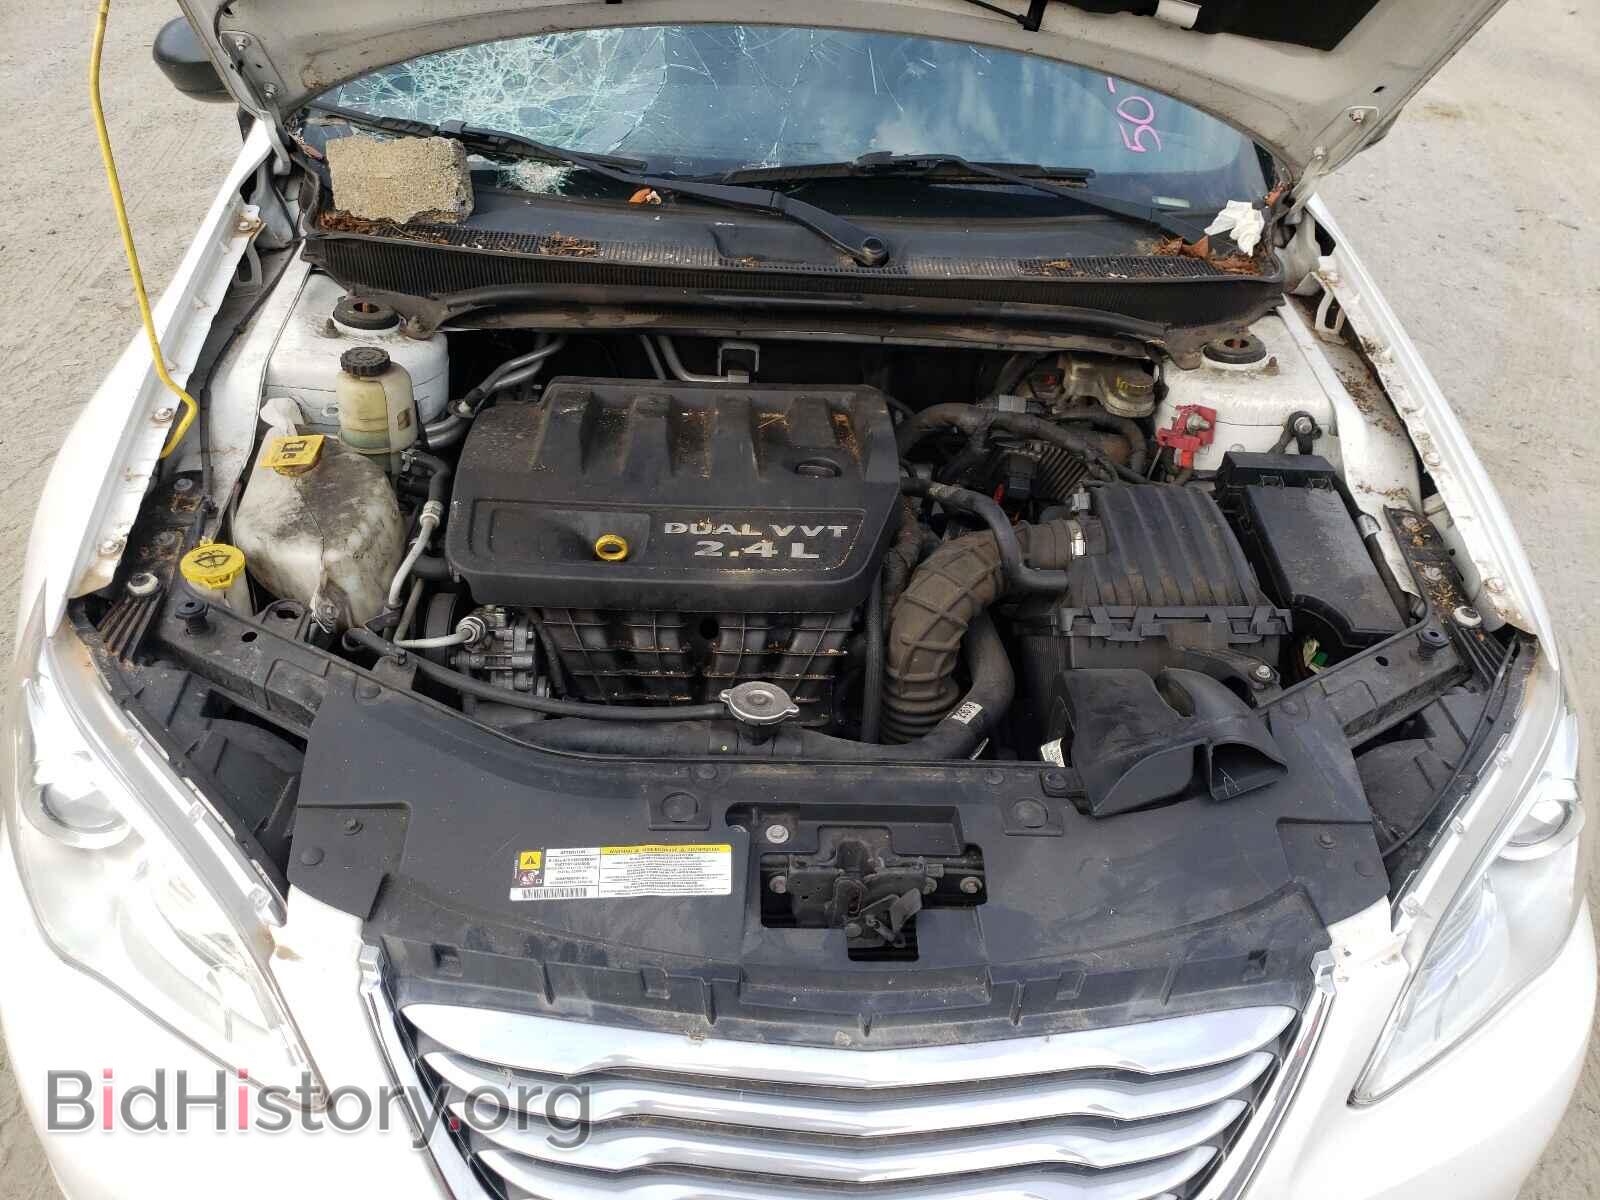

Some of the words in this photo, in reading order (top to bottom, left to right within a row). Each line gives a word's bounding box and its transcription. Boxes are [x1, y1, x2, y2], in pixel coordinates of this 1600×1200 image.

[1107, 77, 1162, 152] 50
[664, 522, 762, 536] DUAL
[768, 524, 848, 537] VVT
